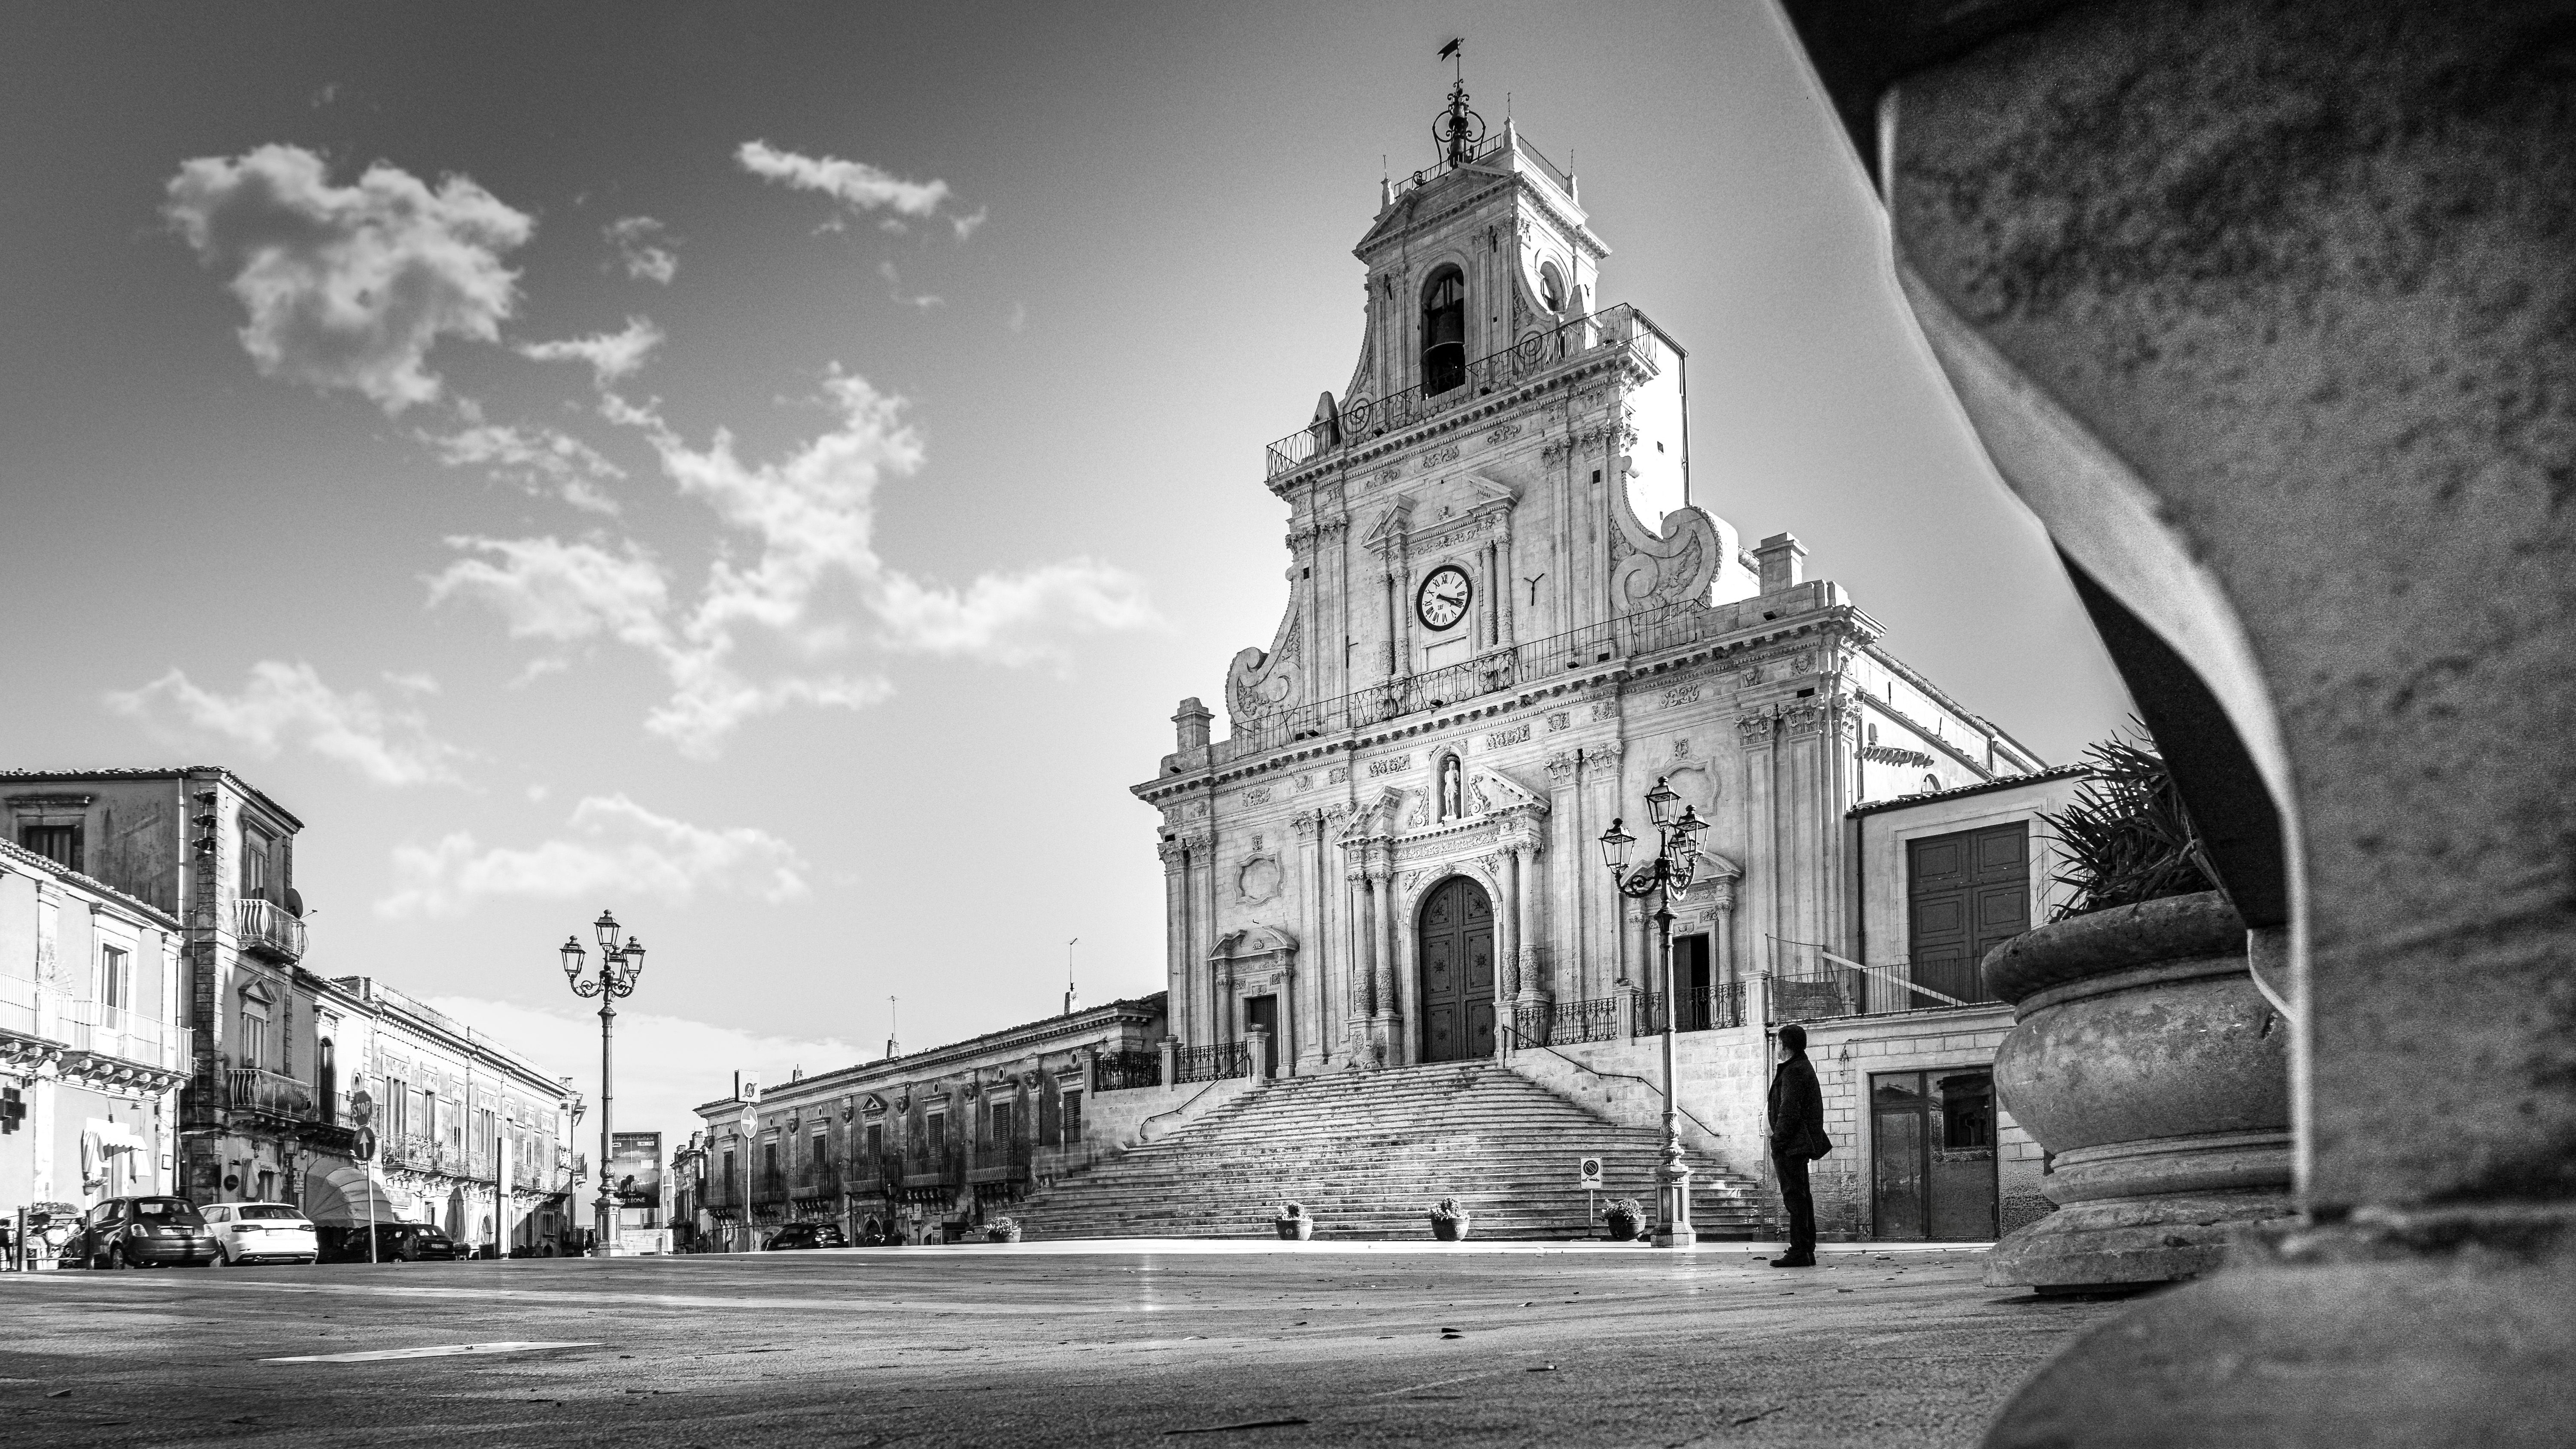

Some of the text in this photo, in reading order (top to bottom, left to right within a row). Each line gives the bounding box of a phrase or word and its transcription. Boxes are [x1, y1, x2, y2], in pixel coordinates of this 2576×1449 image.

[1433, 579, 1440, 589] XI
[1450, 575, 1455, 584] I
[1455, 581, 1462, 589] II
[1443, 613, 1447, 623] VI
[1451, 609, 1456, 618] V
[353, 1101, 371, 1117] STOP
